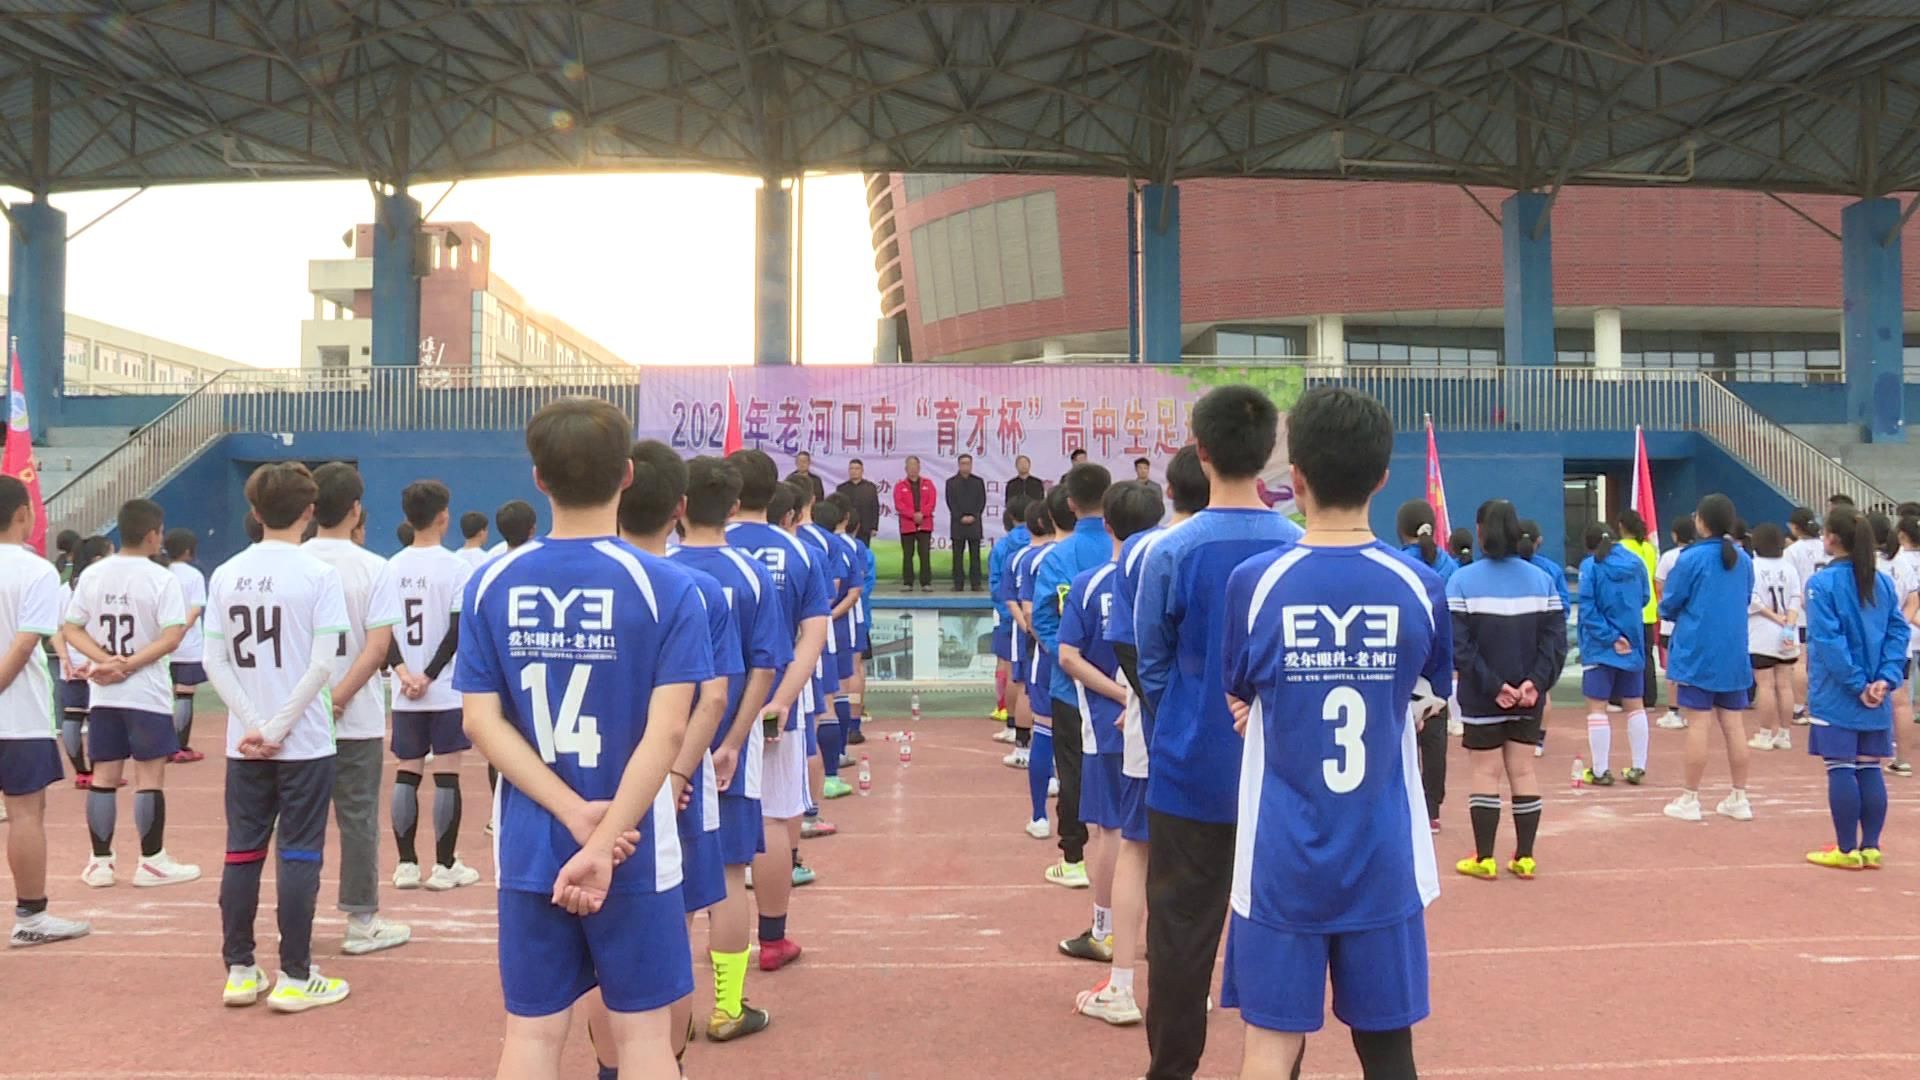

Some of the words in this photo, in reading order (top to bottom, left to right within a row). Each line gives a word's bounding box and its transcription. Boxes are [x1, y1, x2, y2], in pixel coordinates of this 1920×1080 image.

[100, 614, 135, 657] 32
[229, 605, 282, 668] 24
[404, 598, 423, 646] 5
[520, 662, 601, 768] 14
[1322, 686, 1367, 794] 3
